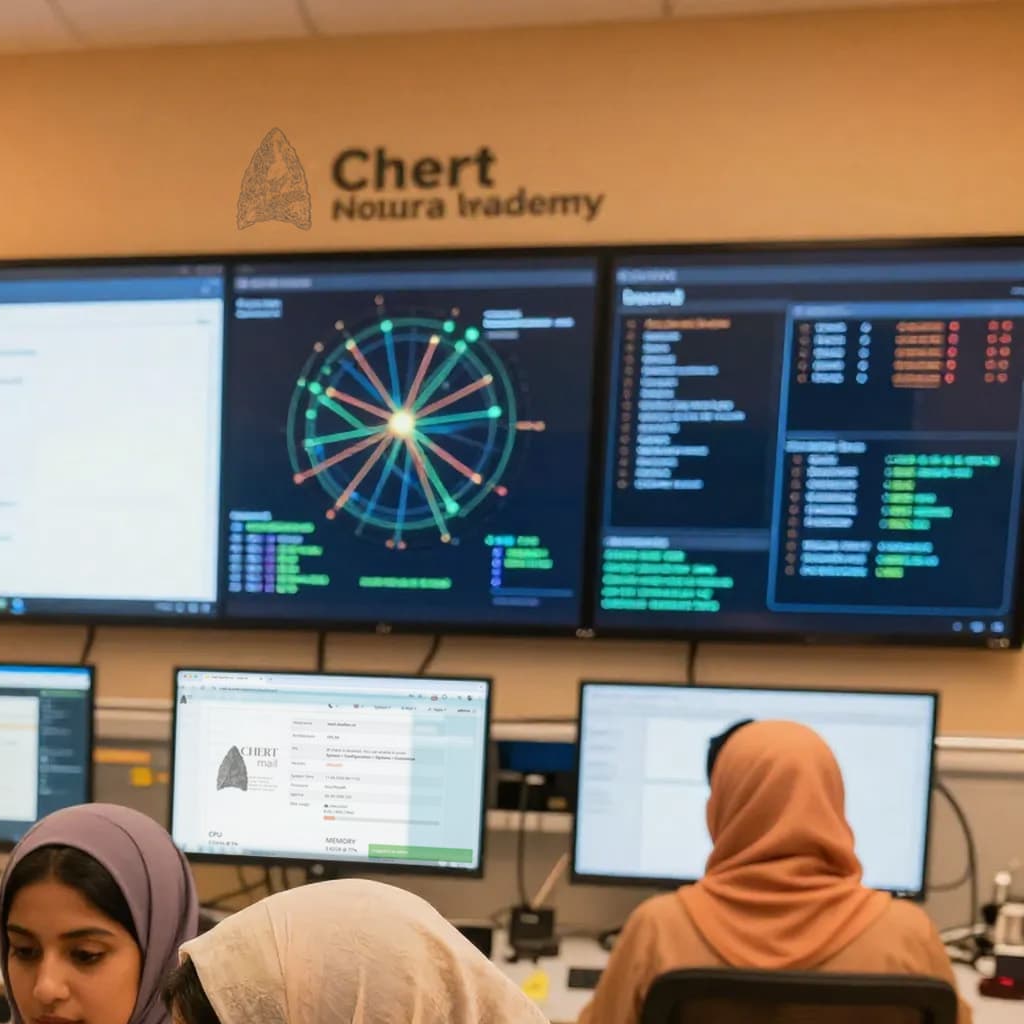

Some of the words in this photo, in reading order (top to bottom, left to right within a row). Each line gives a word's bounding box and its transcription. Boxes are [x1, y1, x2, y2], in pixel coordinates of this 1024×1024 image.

[331, 147, 497, 191] Chert
[240, 746, 279, 757] CHERT
[257, 759, 278, 768] mail
[325, 837, 356, 845] MEMORY
